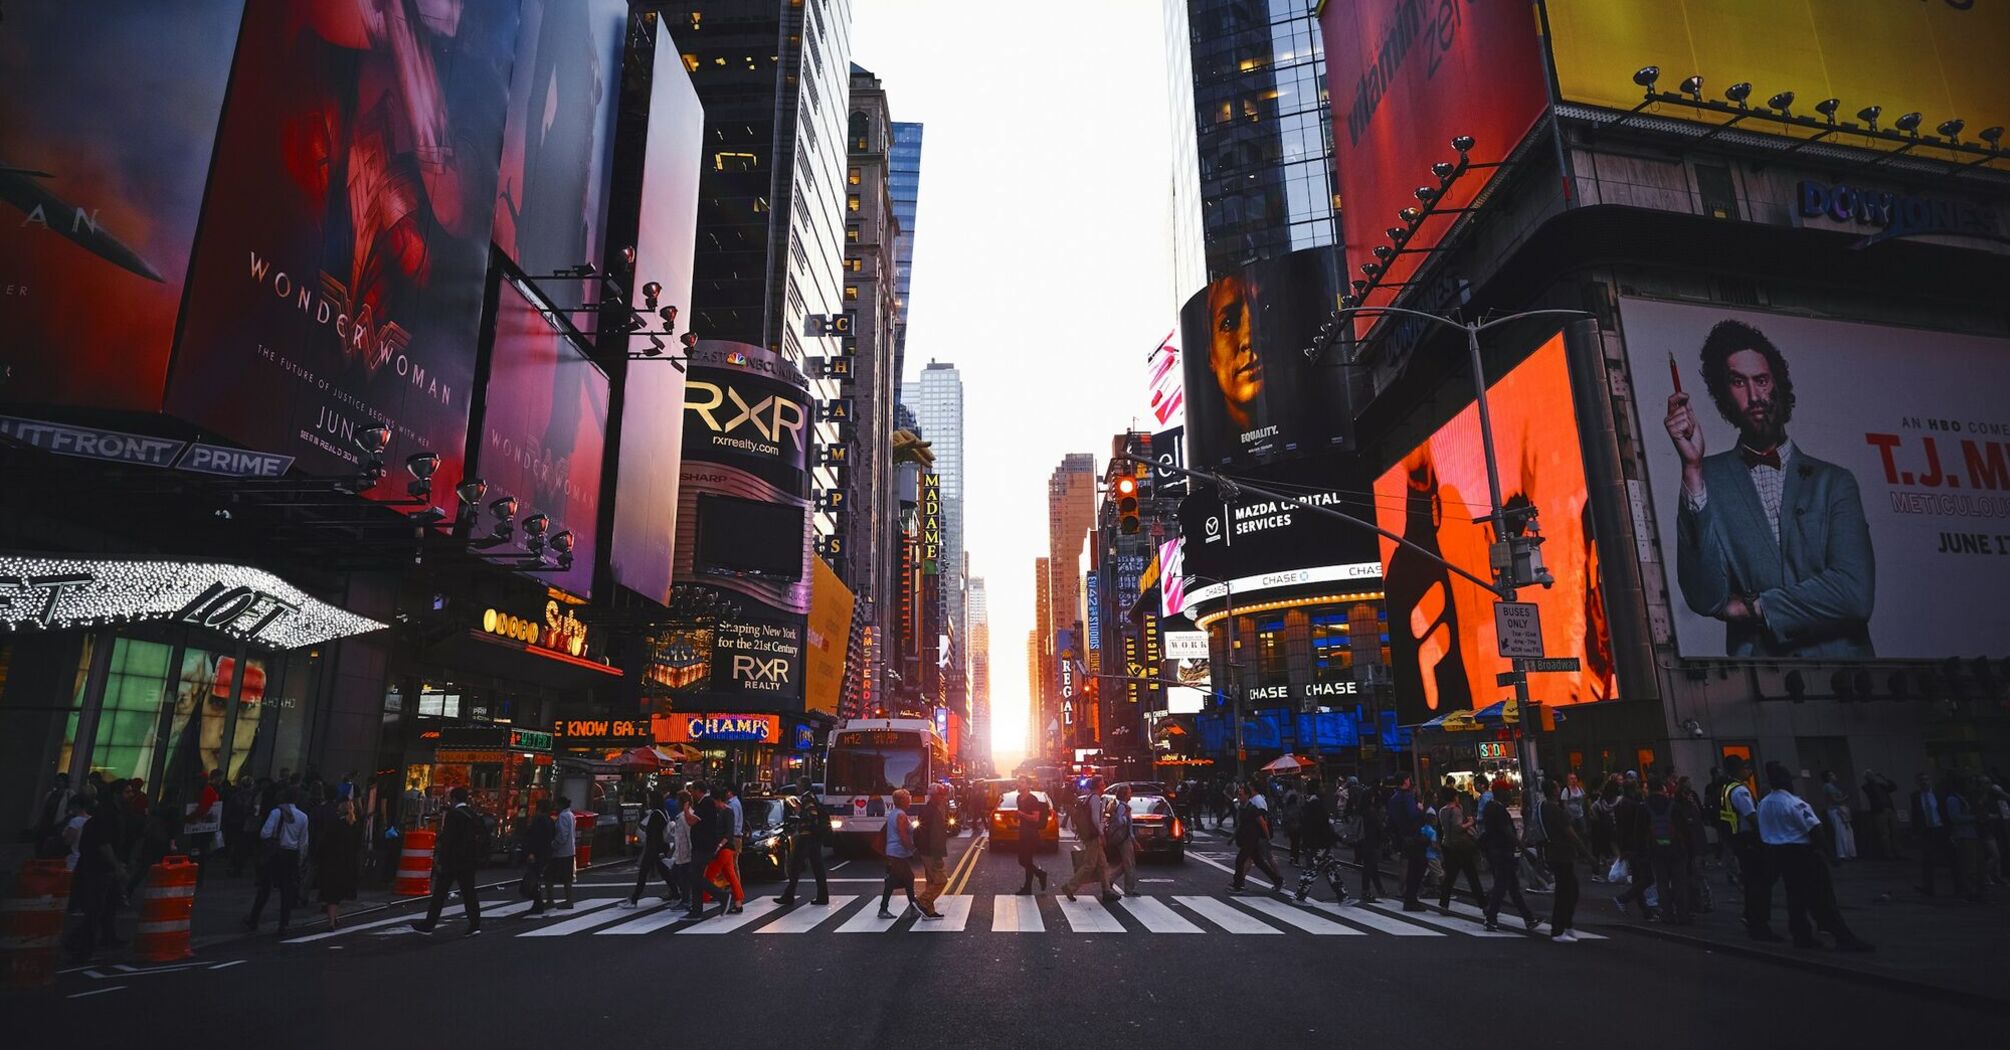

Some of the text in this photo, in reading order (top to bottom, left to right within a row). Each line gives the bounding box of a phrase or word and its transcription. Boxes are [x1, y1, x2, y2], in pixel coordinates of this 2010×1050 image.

[251, 251, 450, 405] WONDER WOMAN
[257, 344, 275, 361] THE
[280, 356, 315, 384] FUTURE
[318, 378, 330, 395] OF
[333, 388, 366, 412] JUSTICE
[368, 407, 396, 429] BEGINS
[315, 405, 357, 443] JUN
[685, 379, 805, 453] RXR
[1902, 416, 1922, 430] AN
[1928, 418, 1961, 432] HBO
[830, 313, 849, 554] CHAMPS
[1240, 424, 1279, 444] EQUALITY.
[713, 434, 780, 456] rxrrealty.com
[192, 447, 282, 477] PRIME
[492, 429, 594, 509] WONDER WOMAN
[1865, 432, 1961, 488] T.J.
[681, 473, 728, 483] SHARP
[923, 474, 941, 559] MADAME
[1234, 501, 1278, 520] MAZDA
[1235, 513, 1292, 535] SERVICES
[1938, 532, 1993, 555] JUNE
[1262, 573, 1298, 586] CHASE
[1348, 564, 1382, 576] CHAS
[182, 581, 299, 639] LOFT
[1503, 607, 1530, 617] BUSES
[762, 625, 782, 638] New
[782, 626, 797, 640] York
[1089, 616, 1100, 650] STUDIOS
[1507, 619, 1528, 629] ONLY
[718, 636, 798, 658] for the 21st Century
[1145, 614, 1159, 661] VICTORY
[733, 655, 790, 684] RXR
[1537, 659, 1577, 672] Broadway
[744, 681, 781, 690] REALTY
[1062, 659, 1073, 725] REGAL
[1250, 686, 1288, 700] CHASE
[1305, 682, 1358, 697] CHASE
[567, 720, 609, 737] KNOW
[612, 720, 649, 737] GAE
[688, 717, 770, 738] CHAMPS
[1480, 743, 1507, 757] SODA
